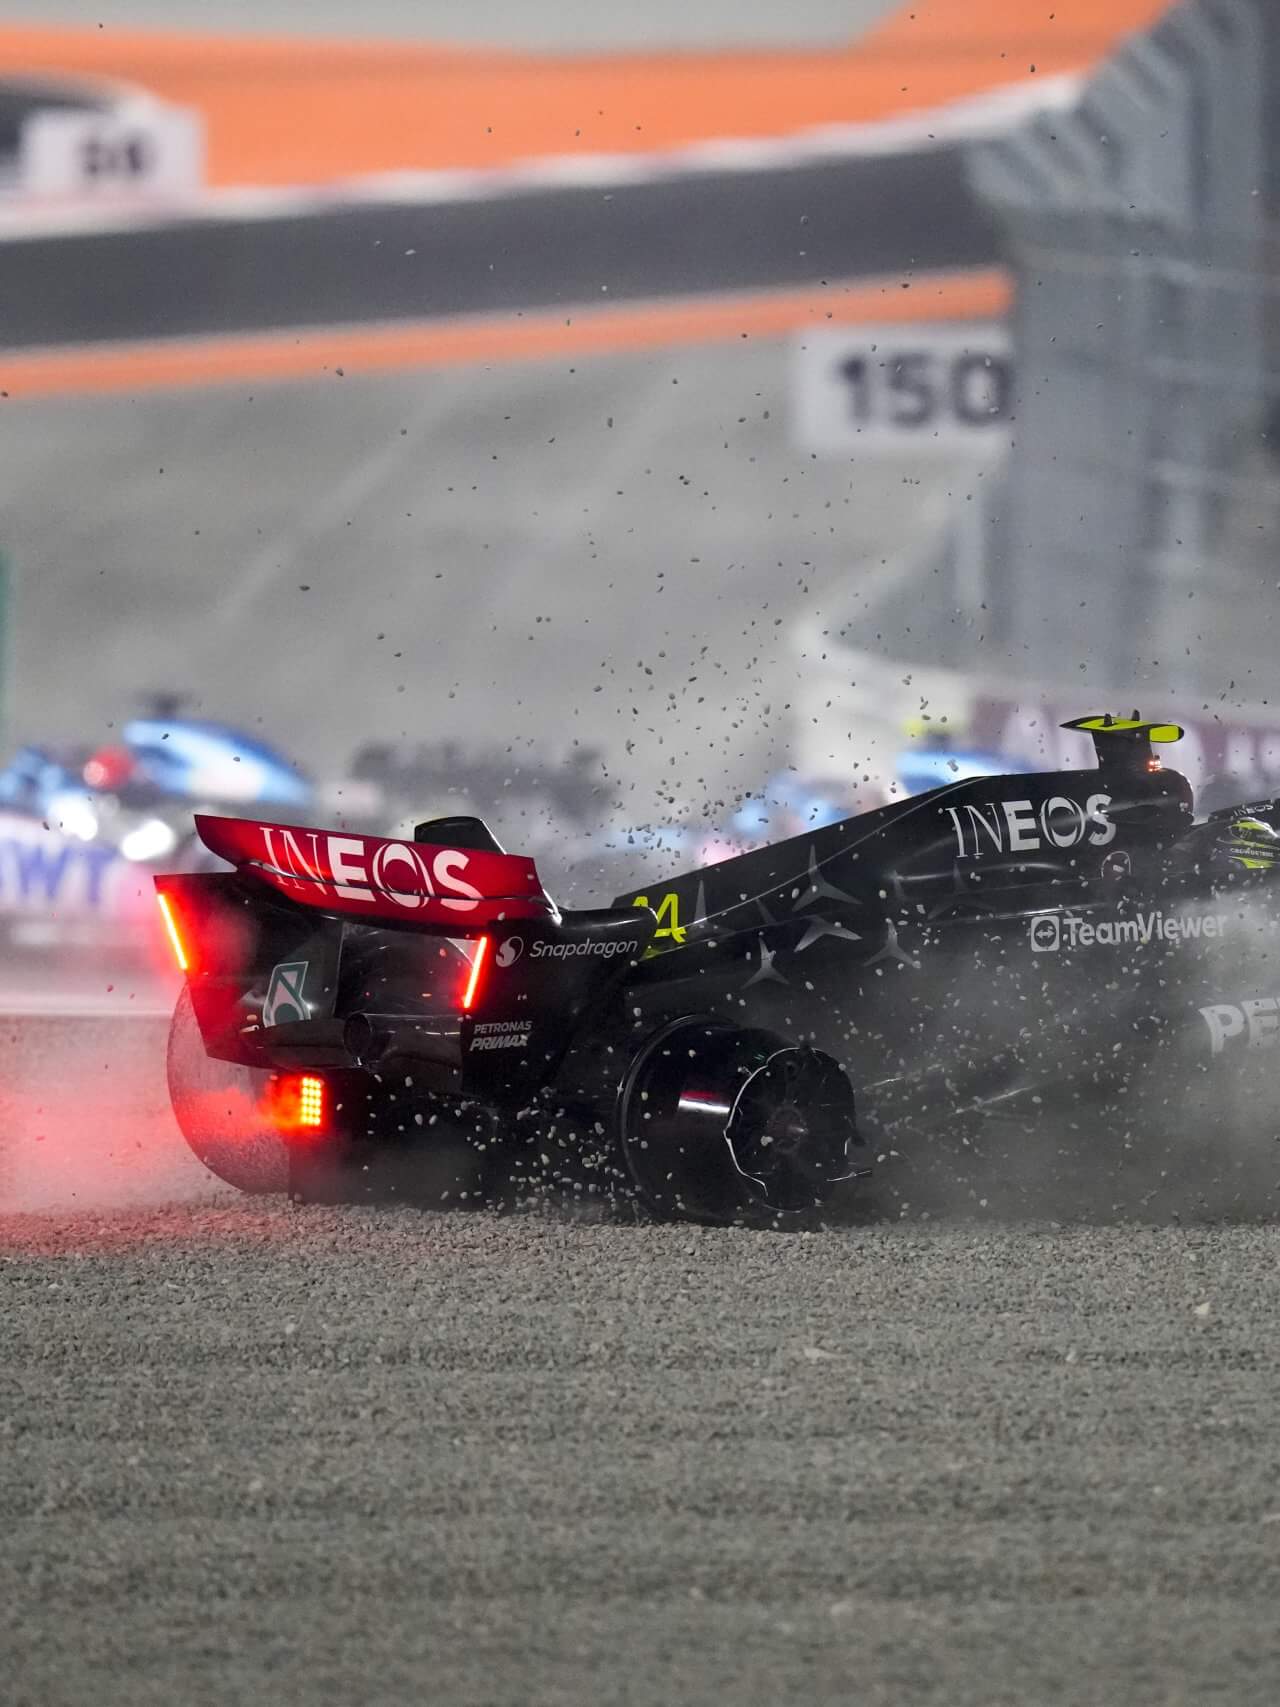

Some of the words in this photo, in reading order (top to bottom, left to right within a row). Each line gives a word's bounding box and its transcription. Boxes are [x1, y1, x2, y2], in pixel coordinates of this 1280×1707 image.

[838, 354, 1014, 428] 150
[944, 793, 1117, 858] INEOS
[259, 826, 485, 912] INEOS
[1063, 912, 1226, 947] TeamViewer
[529, 937, 639, 961] Snapdragon
[469, 1034, 529, 1052] PRIMAX
[473, 1020, 533, 1035] PETRONAS
